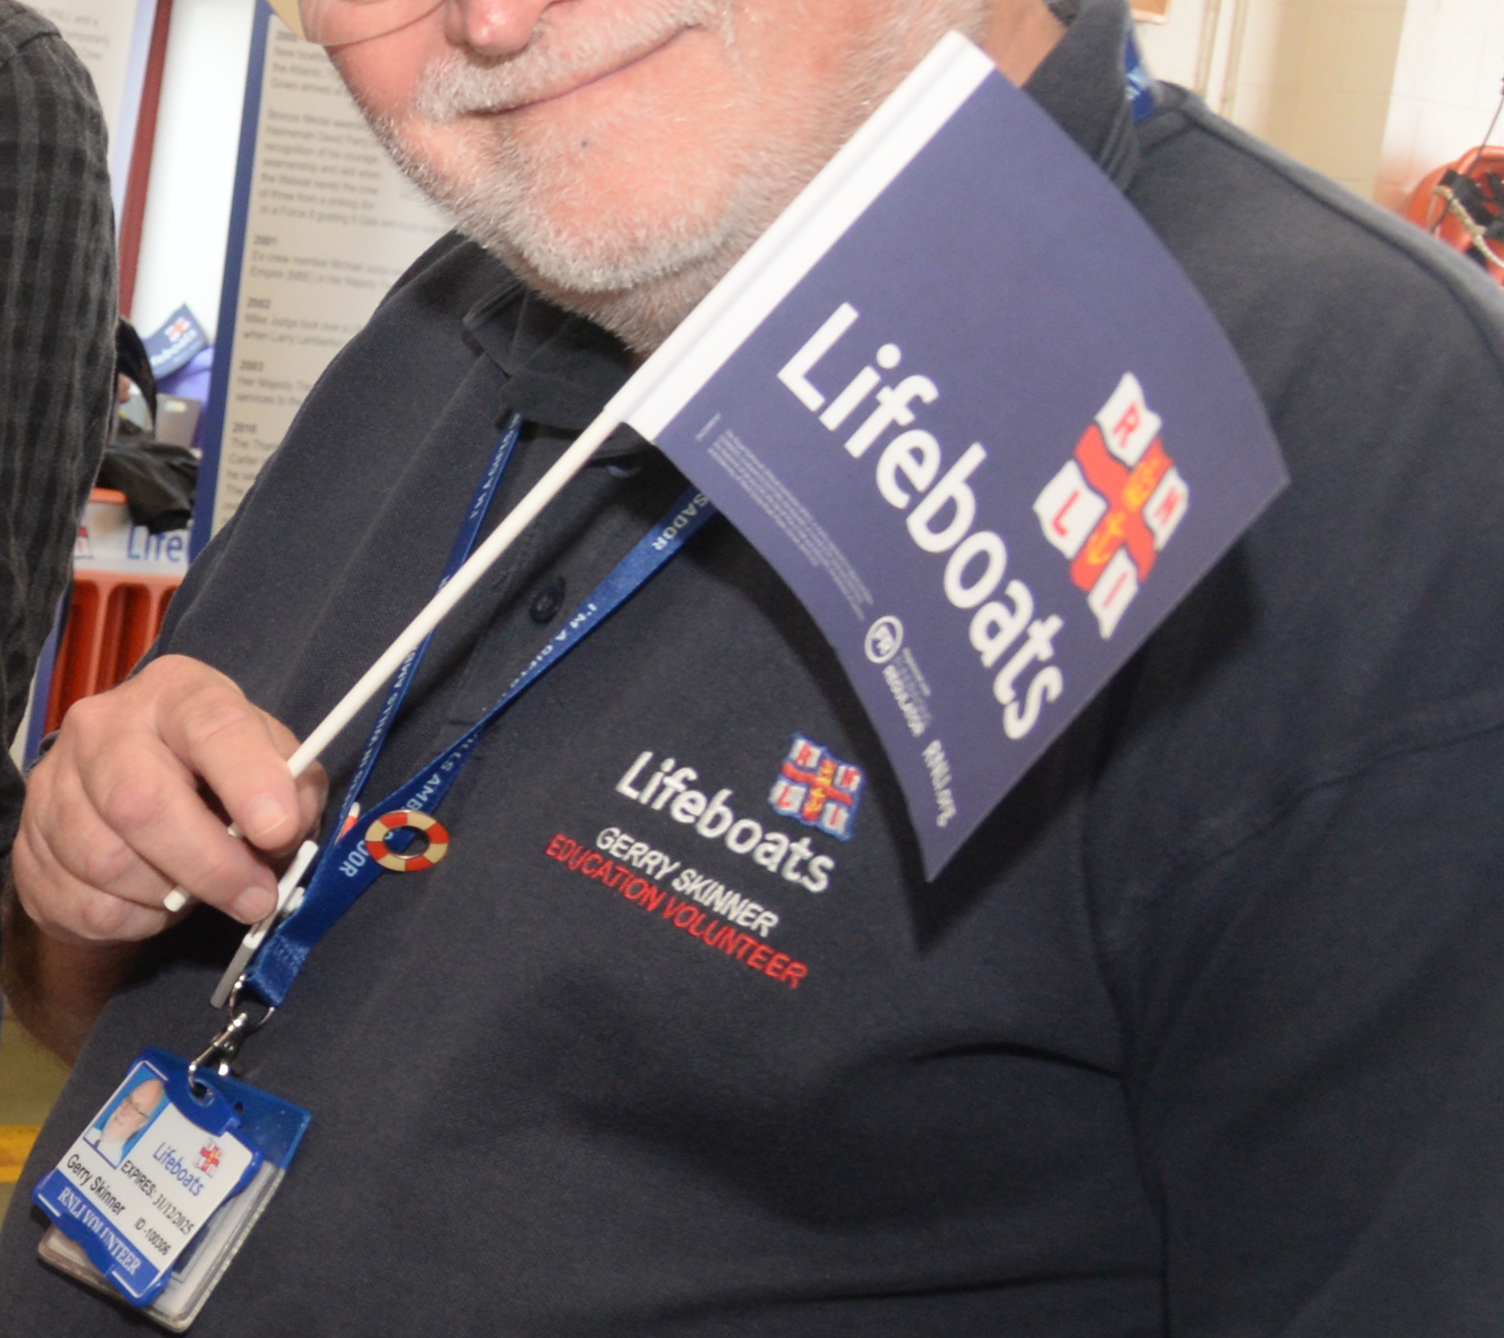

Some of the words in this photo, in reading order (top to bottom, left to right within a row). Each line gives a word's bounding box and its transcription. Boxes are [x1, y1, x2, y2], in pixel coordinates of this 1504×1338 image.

[777, 301, 1064, 740] Lifeboats
[616, 751, 835, 893] Lifeboats
[545, 834, 666, 912] EDUCATION
[662, 896, 808, 988] VOLUNTEER
[595, 826, 680, 881] GERRY
[672, 868, 780, 938] SKINNER
[67, 1154, 92, 1185] Gerry
[89, 1176, 126, 1216] Skinner
[121, 1160, 157, 1199] EXPIRES:
[152, 1142, 205, 1197] Lifeboats
[57, 1187, 83, 1220] RNLI
[83, 1216, 141, 1276] VOLUNTEER
